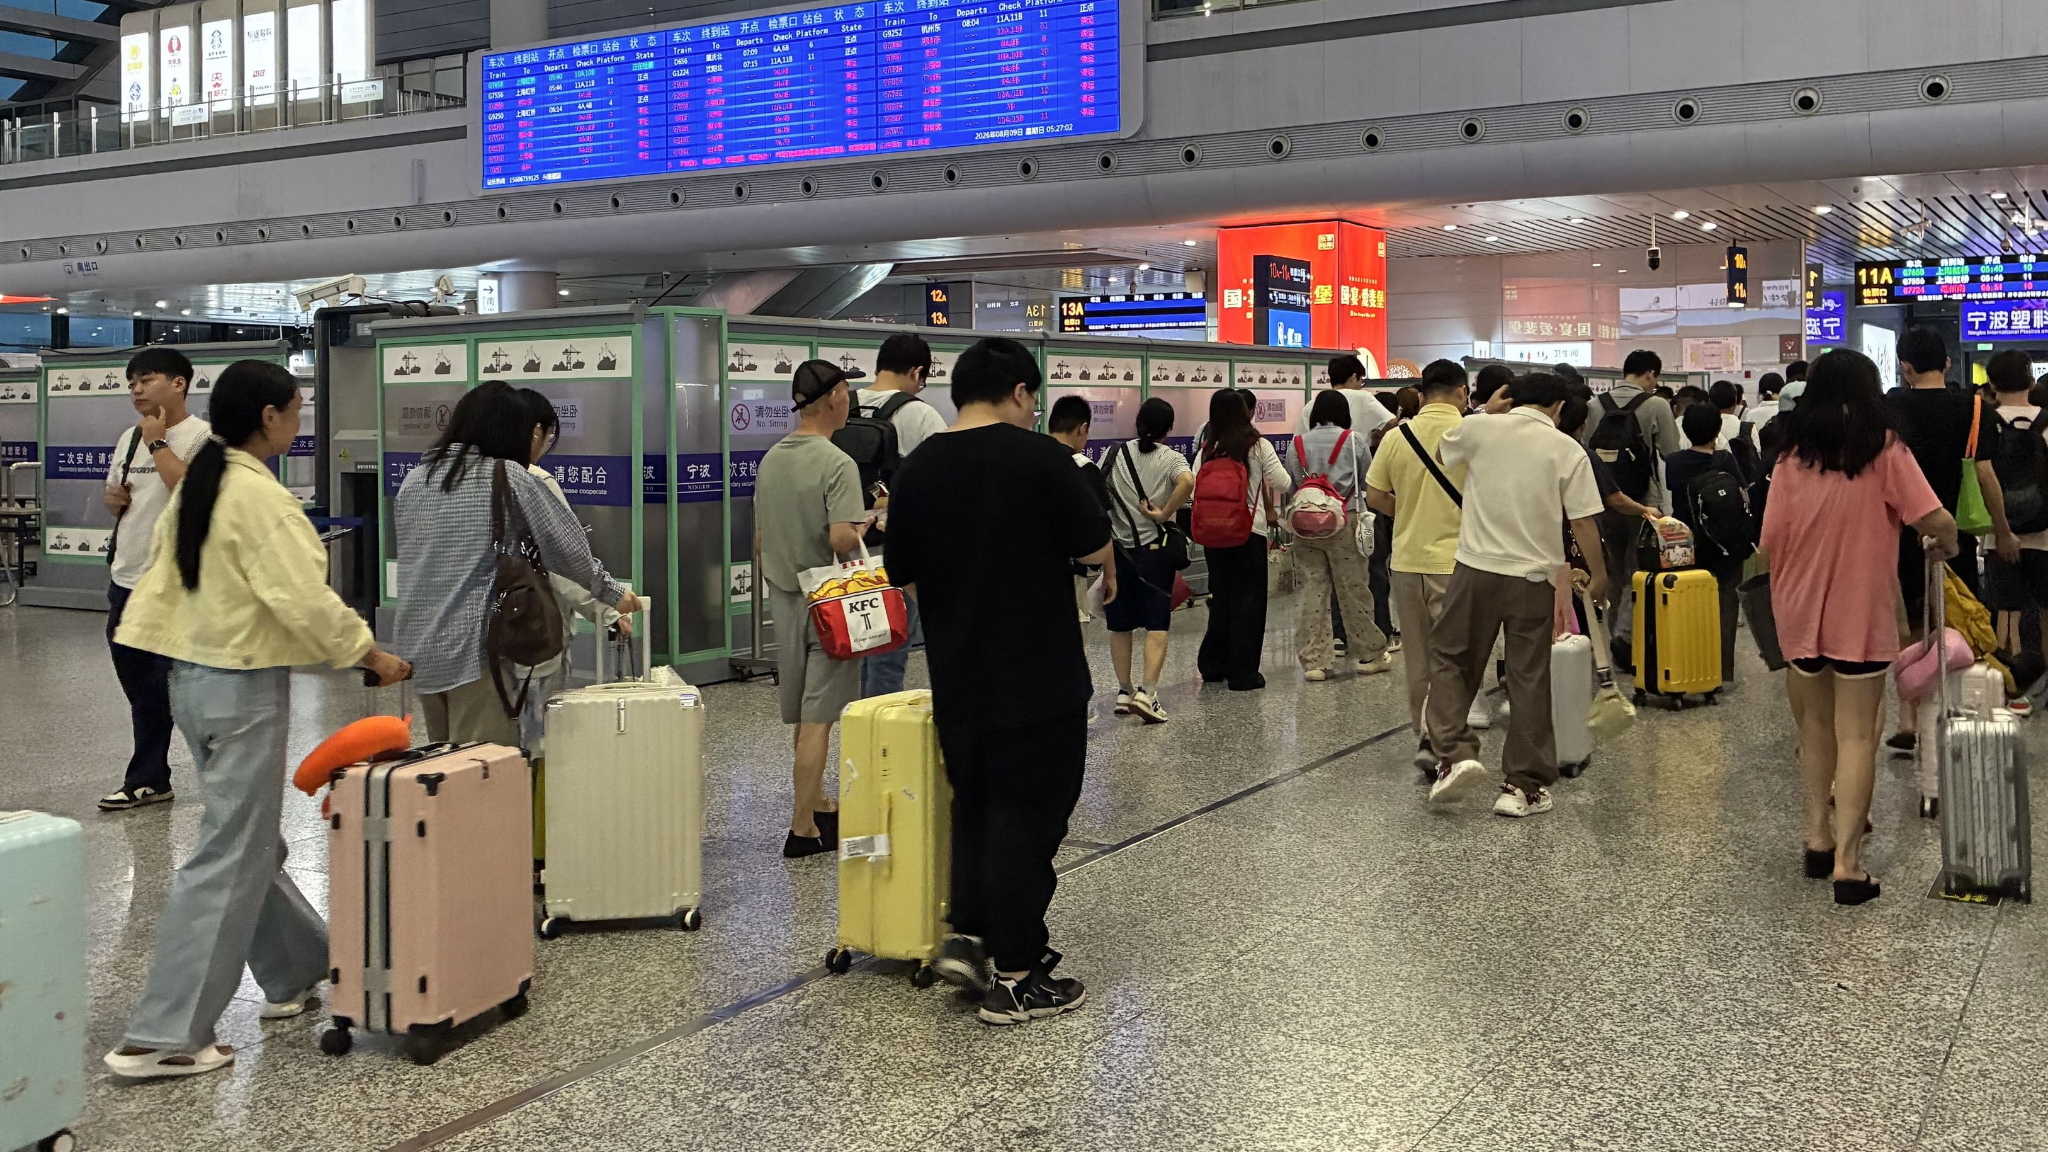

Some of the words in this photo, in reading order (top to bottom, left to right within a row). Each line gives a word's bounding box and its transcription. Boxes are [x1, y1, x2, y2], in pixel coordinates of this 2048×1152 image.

[883, 1, 905, 14] 车次
[884, 17, 905, 27] Train
[928, 12, 938, 21] To
[956, 6, 988, 17] Departs
[998, 1, 1022, 12] Check
[1025, 0, 1063, 8] Platform
[672, 32, 691, 43] 车次
[701, 26, 730, 39] 终到站
[740, 21, 759, 34] 开点
[768, 16, 797, 29] 检票口
[802, 12, 823, 25] 站台
[882, 28, 903, 38] G9252
[921, 23, 941, 35] 杭州东
[961, 18, 980, 28] 08:04
[996, 12, 1023, 23] 11A,11B
[1039, 9, 1048, 18] 11
[1079, 3, 1095, 13] 正点
[673, 46, 692, 55] Train
[736, 37, 763, 47] Departs
[772, 32, 793, 41] Check
[796, 28, 829, 39] Platform
[841, 24, 863, 33] State
[489, 58, 505, 68] 车次
[513, 52, 539, 64] 终到站
[547, 49, 565, 60] 开点
[572, 44, 598, 57] 检票口
[602, 41, 620, 52] 站台
[673, 57, 688, 66] D656
[742, 48, 758, 57] 07:09
[772, 44, 790, 53] 6A,6B
[844, 35, 857, 44] 正点
[489, 71, 506, 80] Train
[544, 64, 568, 73] Departs
[576, 60, 594, 68] Check
[597, 55, 625, 64] Platform
[635, 52, 654, 60] State
[672, 68, 690, 77] G1224
[742, 60, 758, 69] 07:15
[770, 56, 793, 65] 11A,11B
[808, 53, 815, 61] 11
[844, 47, 857, 56] 正点
[548, 73, 563, 81] 05:40
[488, 91, 504, 100] G7556
[548, 84, 563, 92] 05:46
[574, 80, 595, 89] 11A,11B
[637, 73, 649, 82] 正点
[488, 113, 504, 121] G9250
[608, 99, 613, 107] 4
[637, 95, 649, 104] 正点
[975, 127, 1024, 141] 2026年08月09日
[1025, 126, 1045, 136] 星期日
[1046, 123, 1073, 133] 05:27:02
[76, 261, 99, 272] 南出口
[1734, 253, 1747, 269] 10A
[1906, 259, 1923, 268] 车次
[1940, 257, 1965, 267] 终到站
[1984, 256, 2001, 265] 开点
[2019, 254, 2037, 264] 站台
[1980, 264, 2004, 274] 05:40
[2023, 263, 2033, 272] 10
[1858, 267, 1893, 285] 11A
[1980, 274, 2004, 283] 05:46
[2022, 272, 2032, 281] 11
[1734, 282, 1747, 298] 11A
[1862, 288, 1888, 298] 检票口
[2023, 281, 2033, 290] 10
[930, 289, 947, 302] 12A
[1061, 302, 1084, 316] 13A
[930, 311, 948, 325] 13A
[1554, 349, 1579, 358] 卫生间
[755, 405, 791, 419] 请勿坐卧
[756, 420, 766, 428] No
[769, 419, 788, 431] Sitting
[58, 452, 94, 465] 二次安检
[554, 465, 608, 485] 请您配合
[687, 463, 711, 480] 宁波
[579, 488, 608, 496] cooperate
[848, 597, 880, 614] KFC
